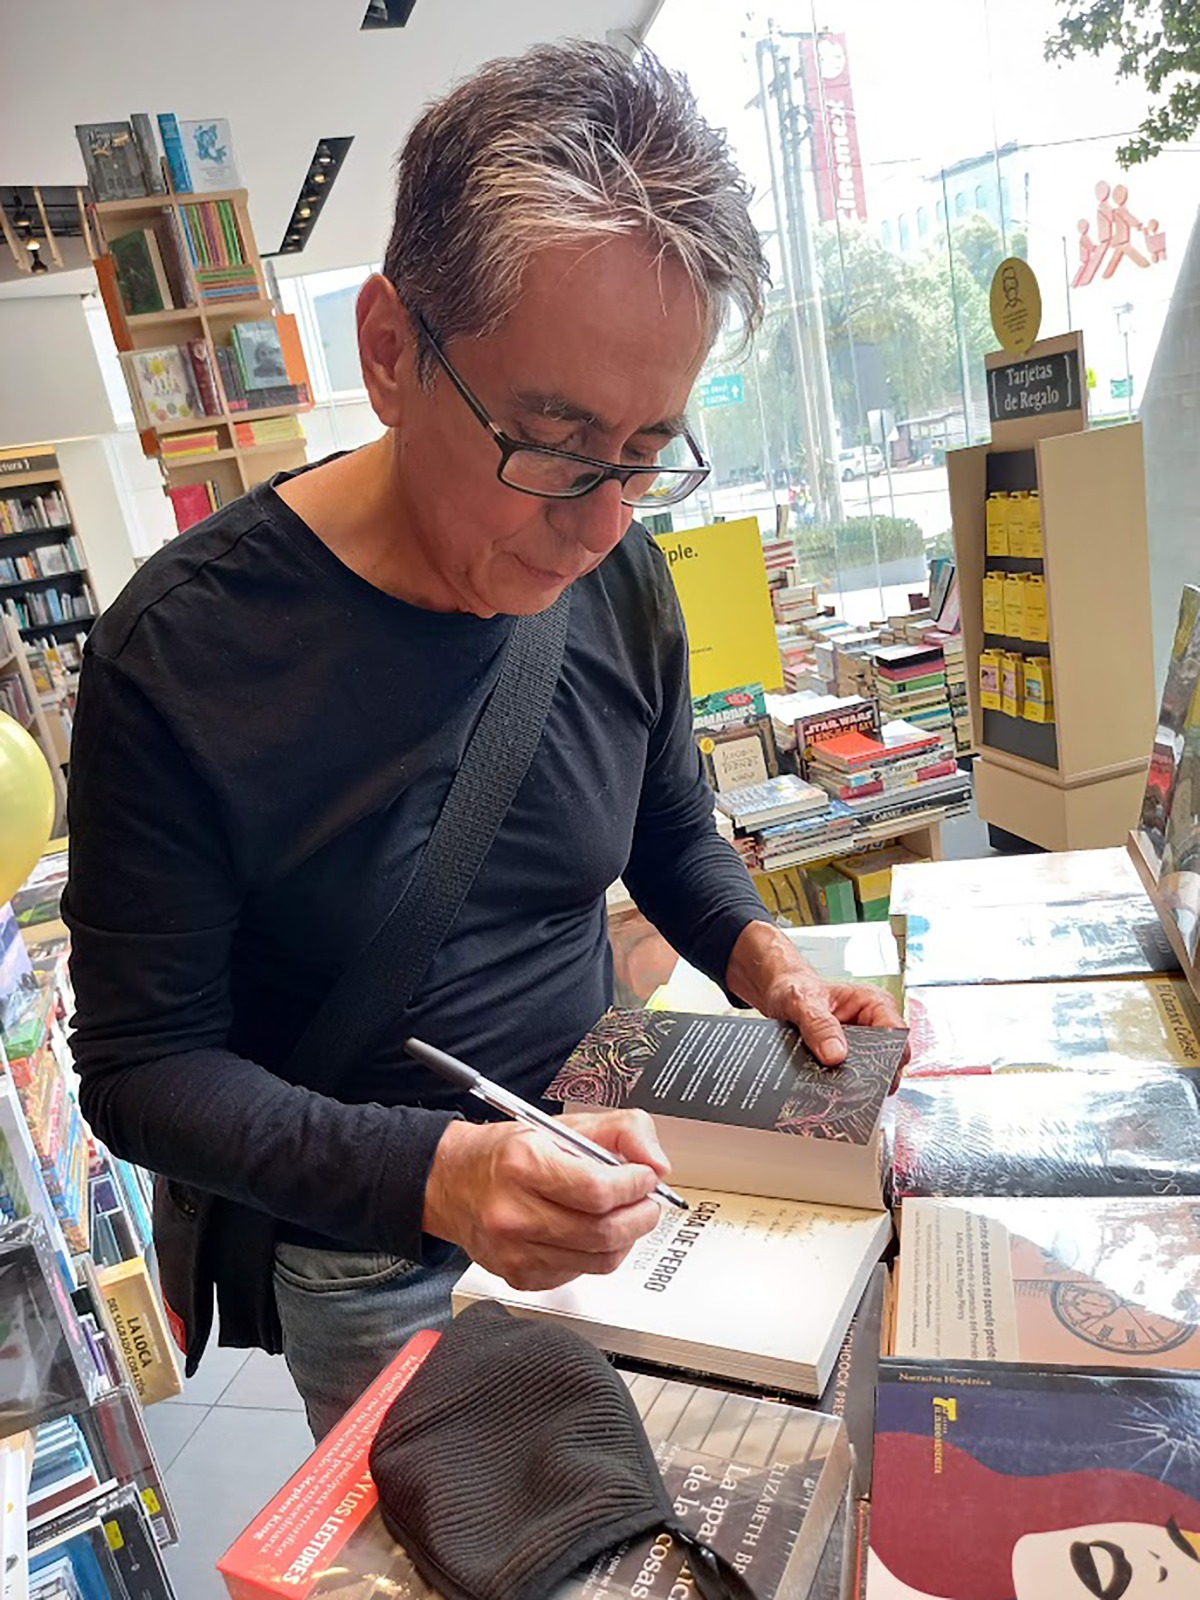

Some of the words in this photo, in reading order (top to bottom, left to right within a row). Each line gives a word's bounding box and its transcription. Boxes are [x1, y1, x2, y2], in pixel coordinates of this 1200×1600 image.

[1005, 364, 1053, 388] Tarjetas
[1004, 393, 1017, 411] de
[1020, 385, 1059, 411] Regalo
[805, 718, 839, 735] STAR
[839, 710, 875, 726] WARS
[683, 1201, 721, 1228] CARA
[671, 1229, 700, 1248] DE
[643, 1248, 688, 1293] PERRO
[107, 1297, 119, 1313] DEL
[113, 1314, 132, 1355] SAGRADO
[127, 1317, 142, 1334] LA
[983, 1299, 995, 1328] puede
[133, 1334, 153, 1369] LOCA
[319, 1455, 343, 1486] prosa
[682, 1465, 712, 1493] de
[719, 1464, 751, 1492] La
[281, 1473, 317, 1516] Stephen
[335, 1492, 363, 1517] LOS
[741, 1462, 790, 1547] ELIZABETH
[253, 1513, 282, 1541] King
[275, 1503, 318, 1557] terrorífico
[282, 1512, 344, 1585] LECTORES
[630, 1533, 673, 1600] cosas
